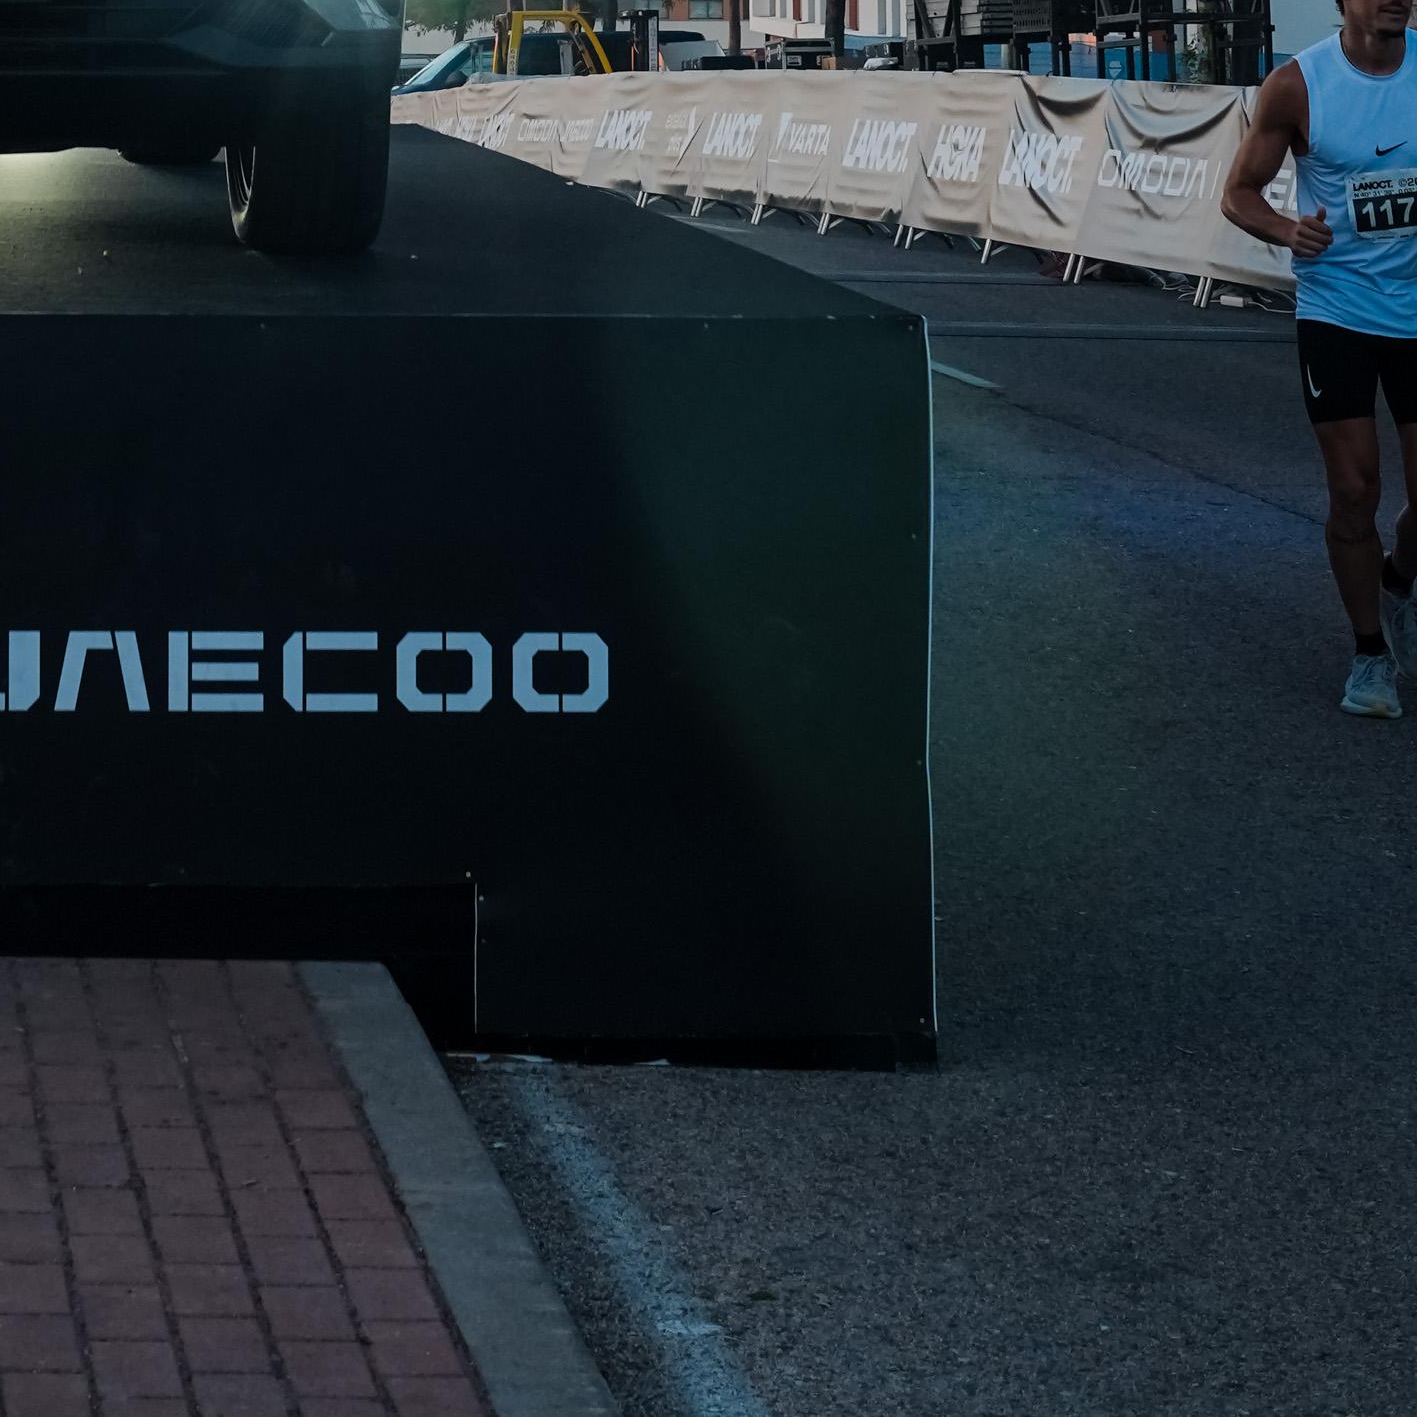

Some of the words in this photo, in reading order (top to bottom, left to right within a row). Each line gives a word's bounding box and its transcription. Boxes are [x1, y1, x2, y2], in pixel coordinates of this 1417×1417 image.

[789, 123, 832, 156] VARTA
[926, 125, 986, 183] HOKA
[1097, 148, 1209, 199] OMODA
[1362, 197, 1415, 227] 117
